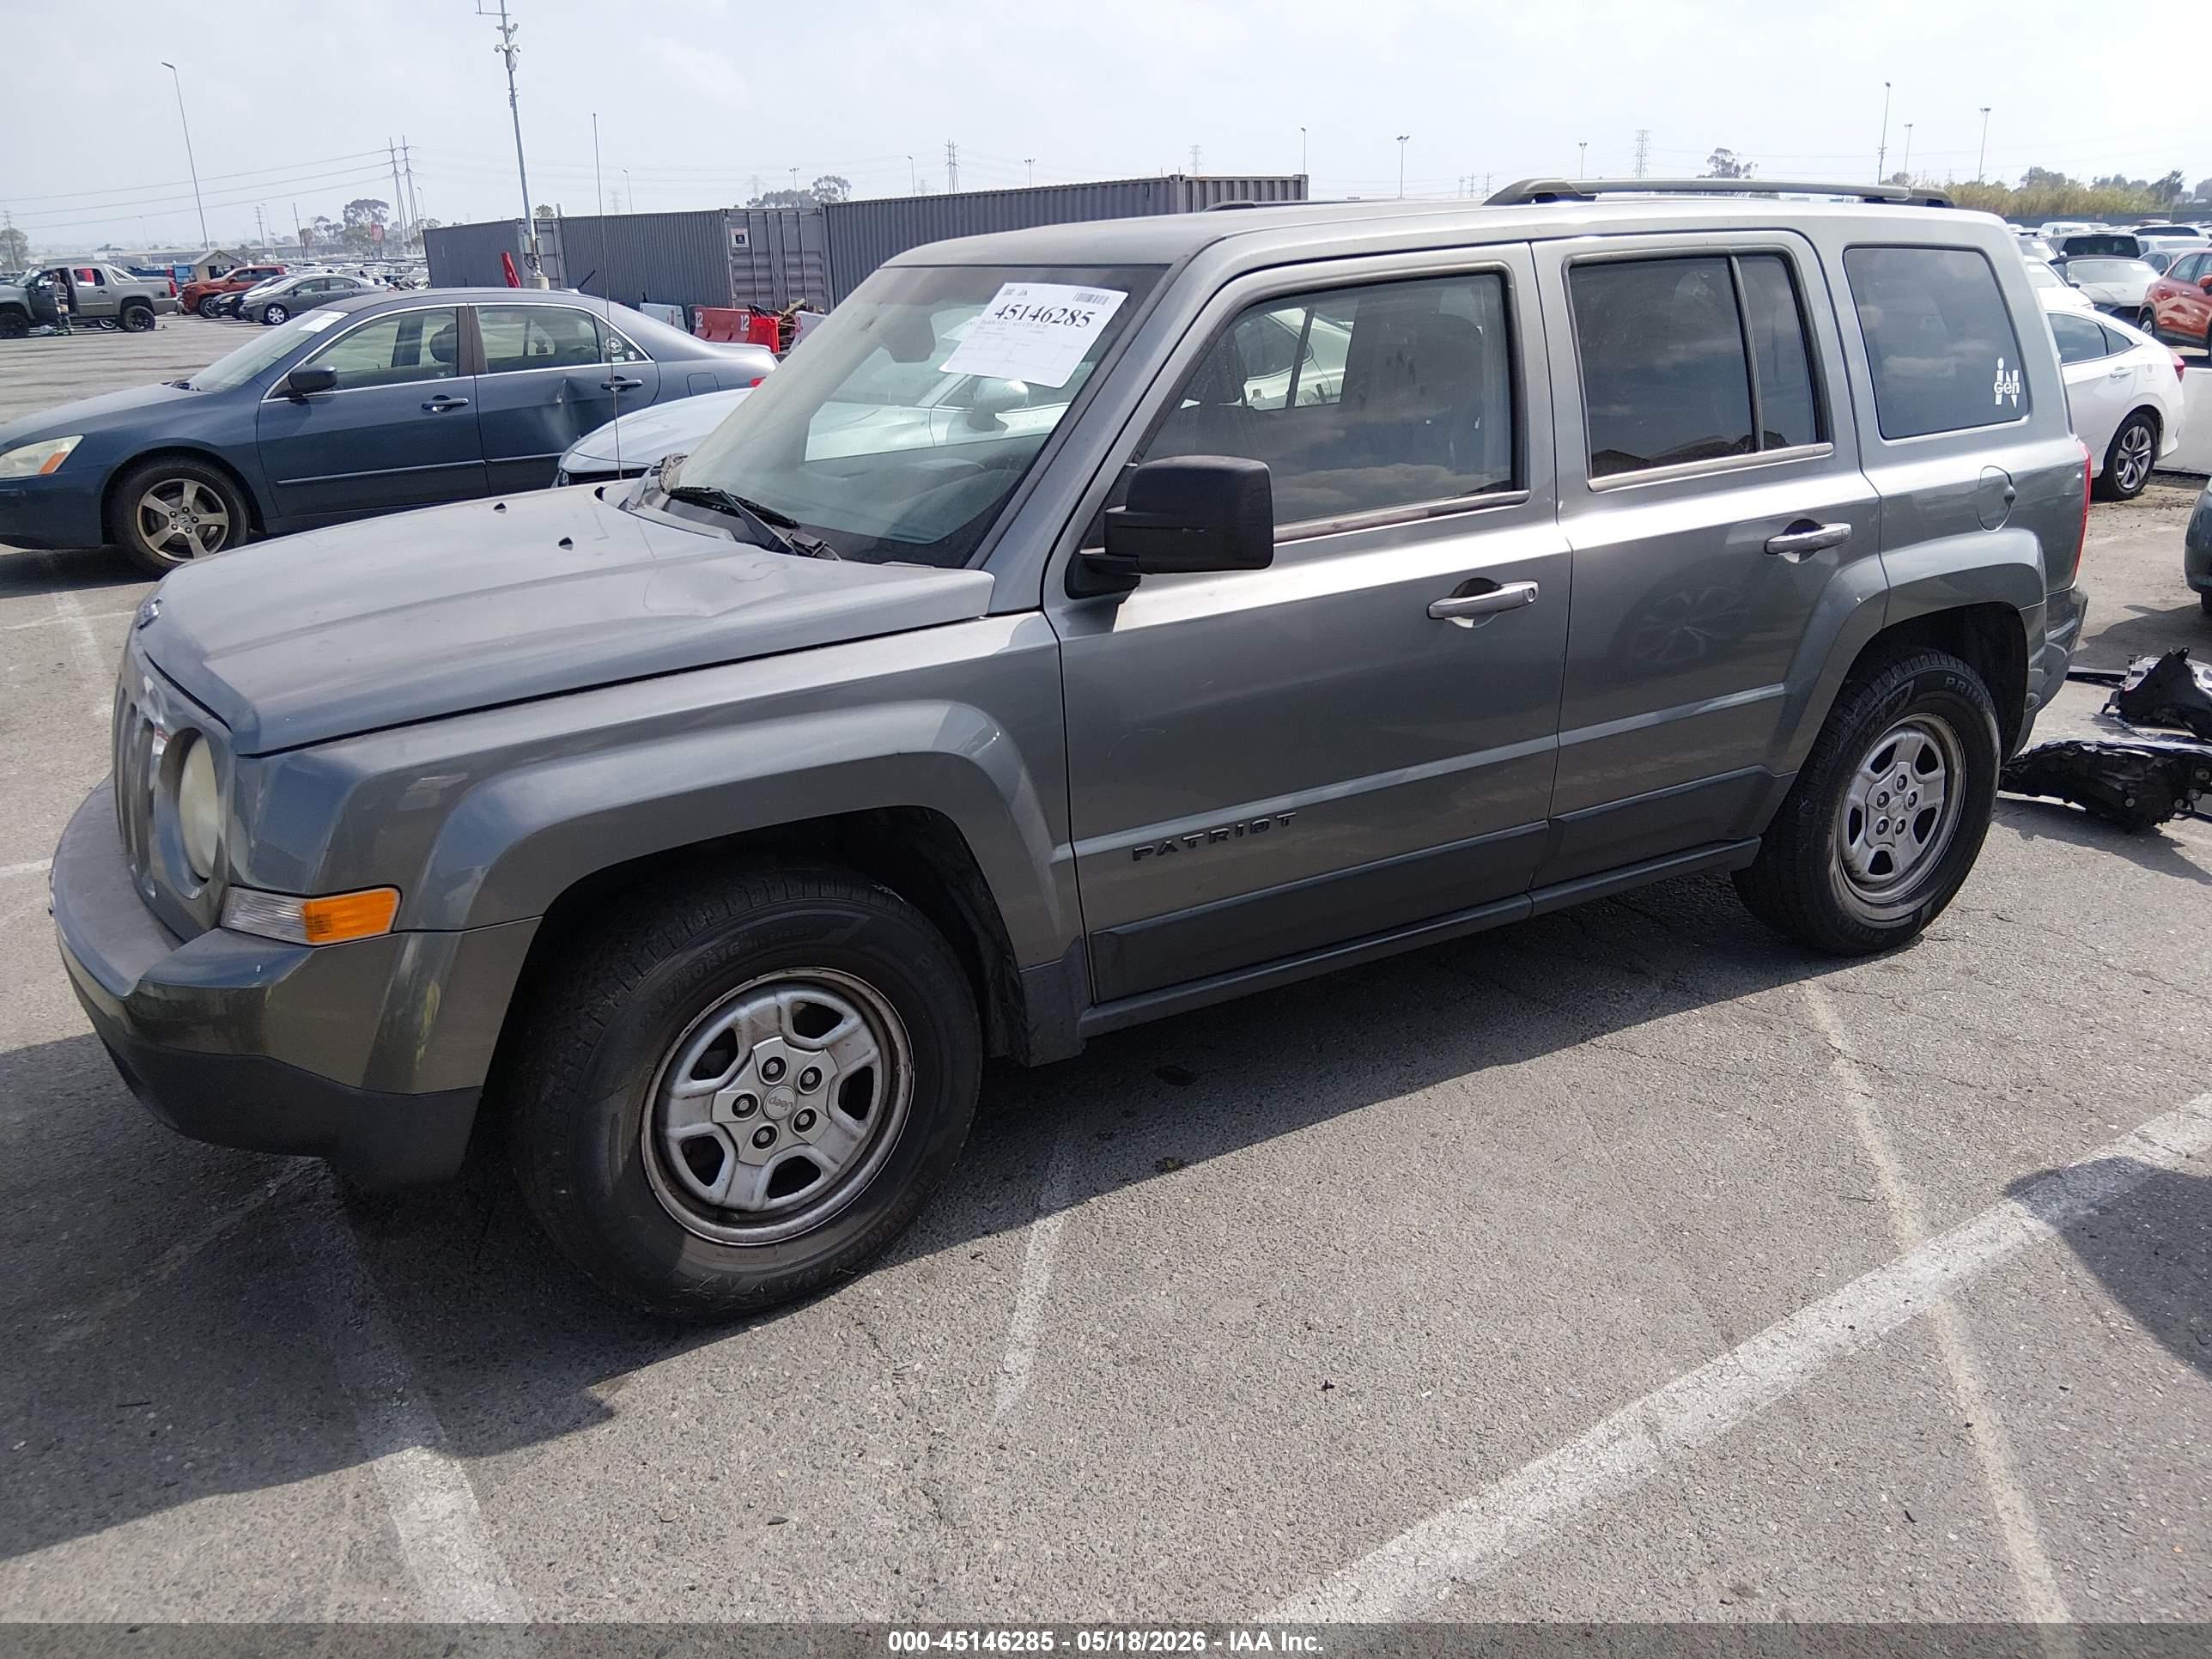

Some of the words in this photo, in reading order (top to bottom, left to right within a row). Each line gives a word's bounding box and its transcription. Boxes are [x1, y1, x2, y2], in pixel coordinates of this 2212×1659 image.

[694, 311, 704, 329] 12
[740, 313, 750, 331] 12
[994, 303, 1097, 328] 45146285
[1132, 811, 1297, 861] PATRIOT
[768, 1095, 794, 1112] Jeep
